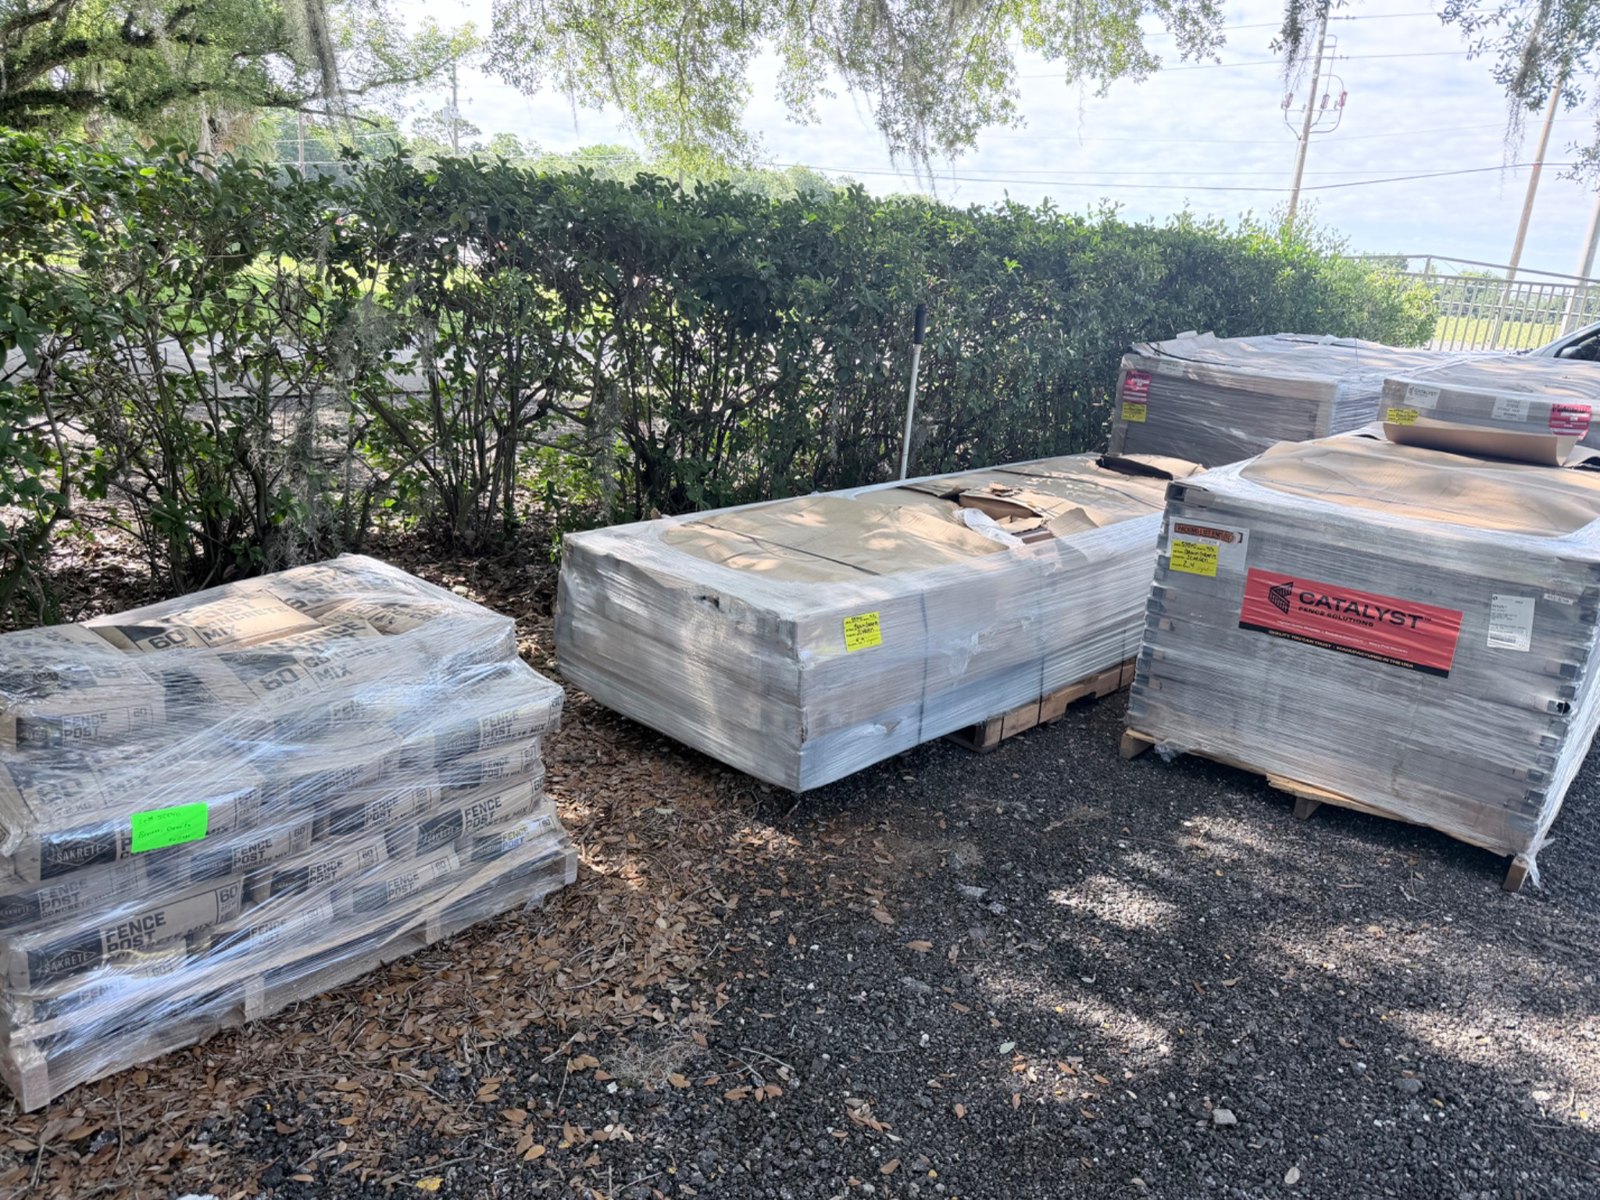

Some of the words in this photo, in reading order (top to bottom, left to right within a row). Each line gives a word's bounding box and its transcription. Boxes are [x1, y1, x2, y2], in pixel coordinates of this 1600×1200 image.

[1298, 606, 1325, 617] FENCE
[1327, 613, 1374, 628] SOLUTIONS
[1299, 592, 1423, 629] CATALYST
[148, 628, 187, 650] 60
[202, 626, 241, 641] MIX
[314, 663, 353, 682] MIX
[63, 712, 107, 727] FENCE
[482, 710, 520, 728] FENCE
[64, 727, 99, 739] POST
[530, 723, 547, 735] MIX
[464, 796, 502, 820] FENCE
[465, 811, 495, 831] POST
[502, 826, 529, 841] FENCE
[233, 839, 272, 857] FENCE
[502, 837, 525, 851] POST
[56, 844, 101, 863] SAKRETE
[234, 850, 265, 867] POST
[309, 860, 344, 876] FENCE
[309, 871, 338, 885] POST
[387, 872, 420, 889] FENCE
[40, 880, 88, 901] FENCE
[220, 885, 238, 903] 60
[388, 882, 414, 899] POST
[41, 892, 79, 911] POST
[106, 911, 167, 943] FENCE
[251, 919, 287, 937] FENCE
[107, 929, 156, 951] POST
[45, 950, 89, 974] SAKRETE
